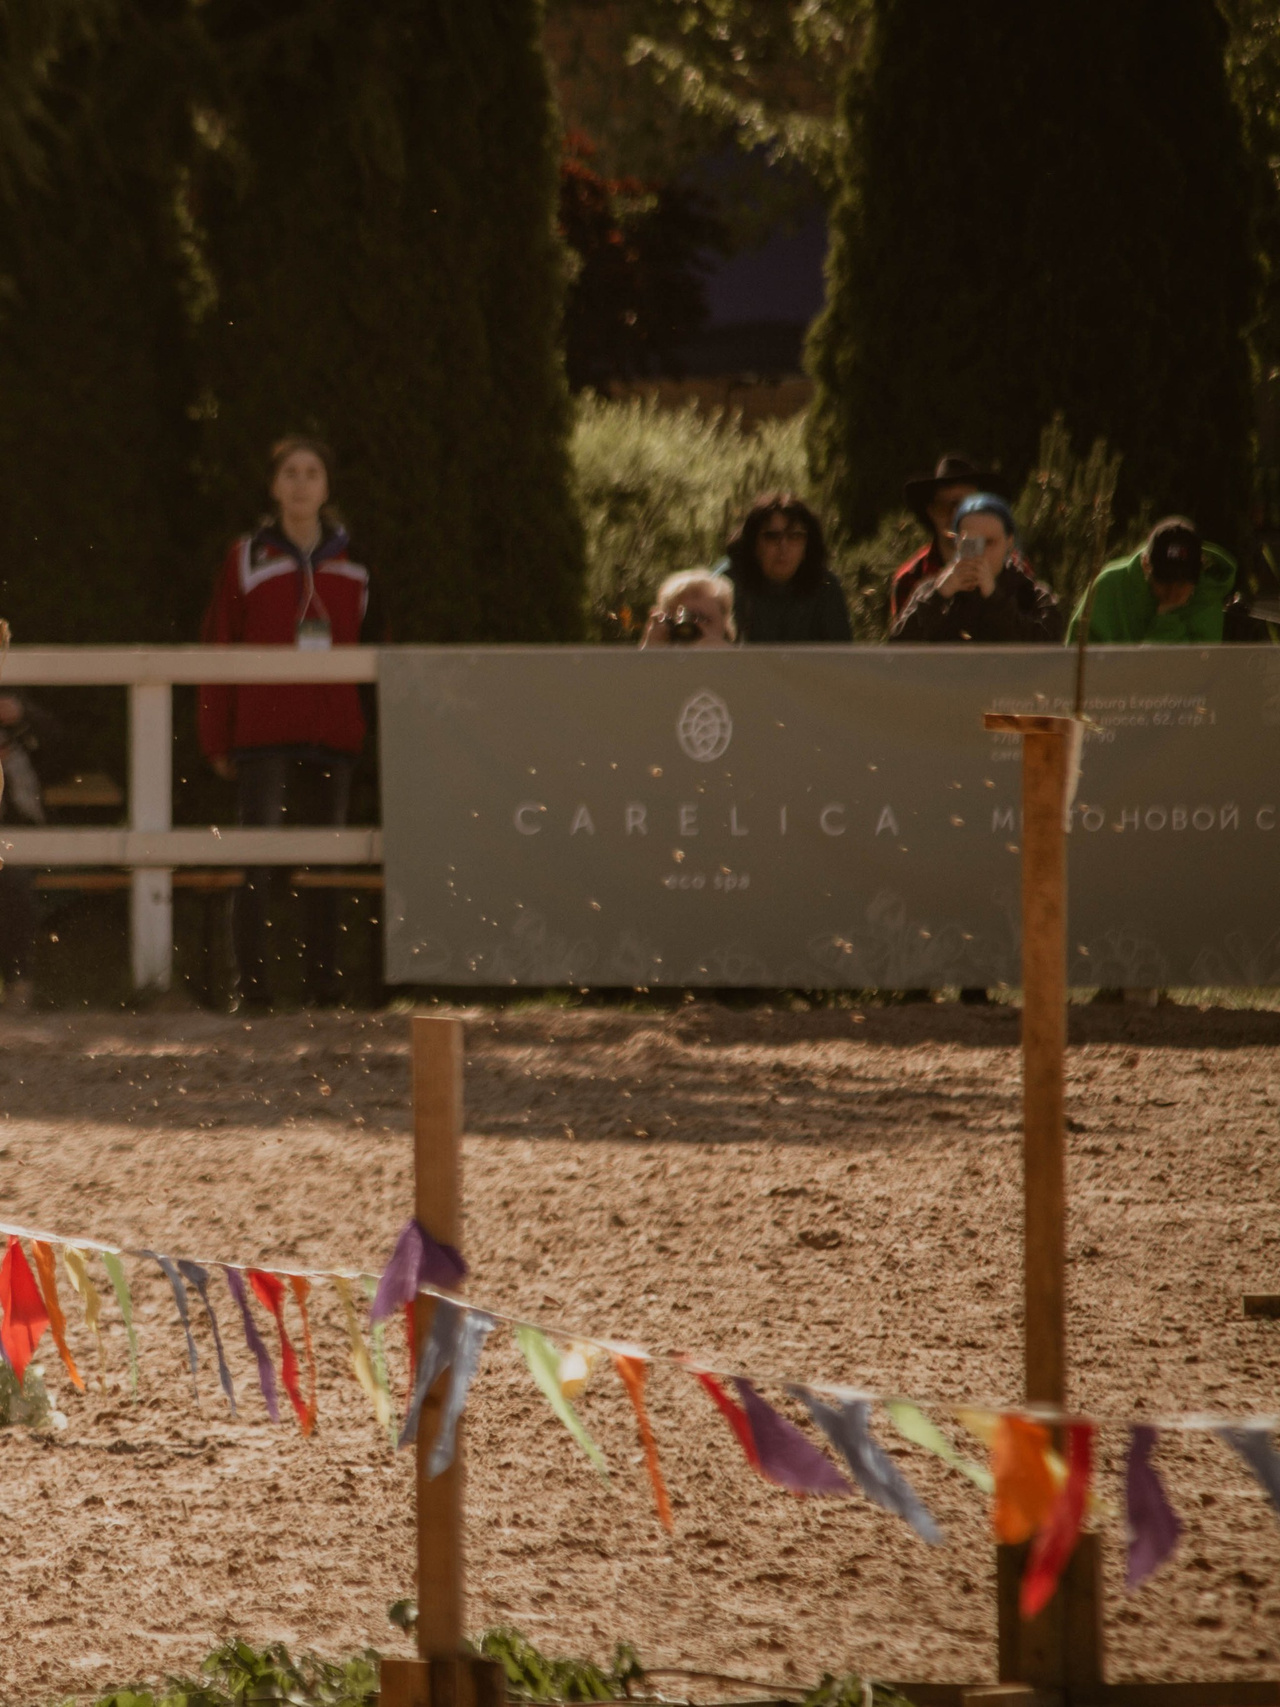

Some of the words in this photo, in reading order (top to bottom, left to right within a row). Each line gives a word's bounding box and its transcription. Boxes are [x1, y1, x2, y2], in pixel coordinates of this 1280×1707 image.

[1130, 694, 1207, 710] Expoforum
[513, 800, 901, 836] CARELICA
[1120, 799, 1240, 831] НОВОЙ
[665, 873, 707, 890] eco
[713, 871, 751, 893] spa
